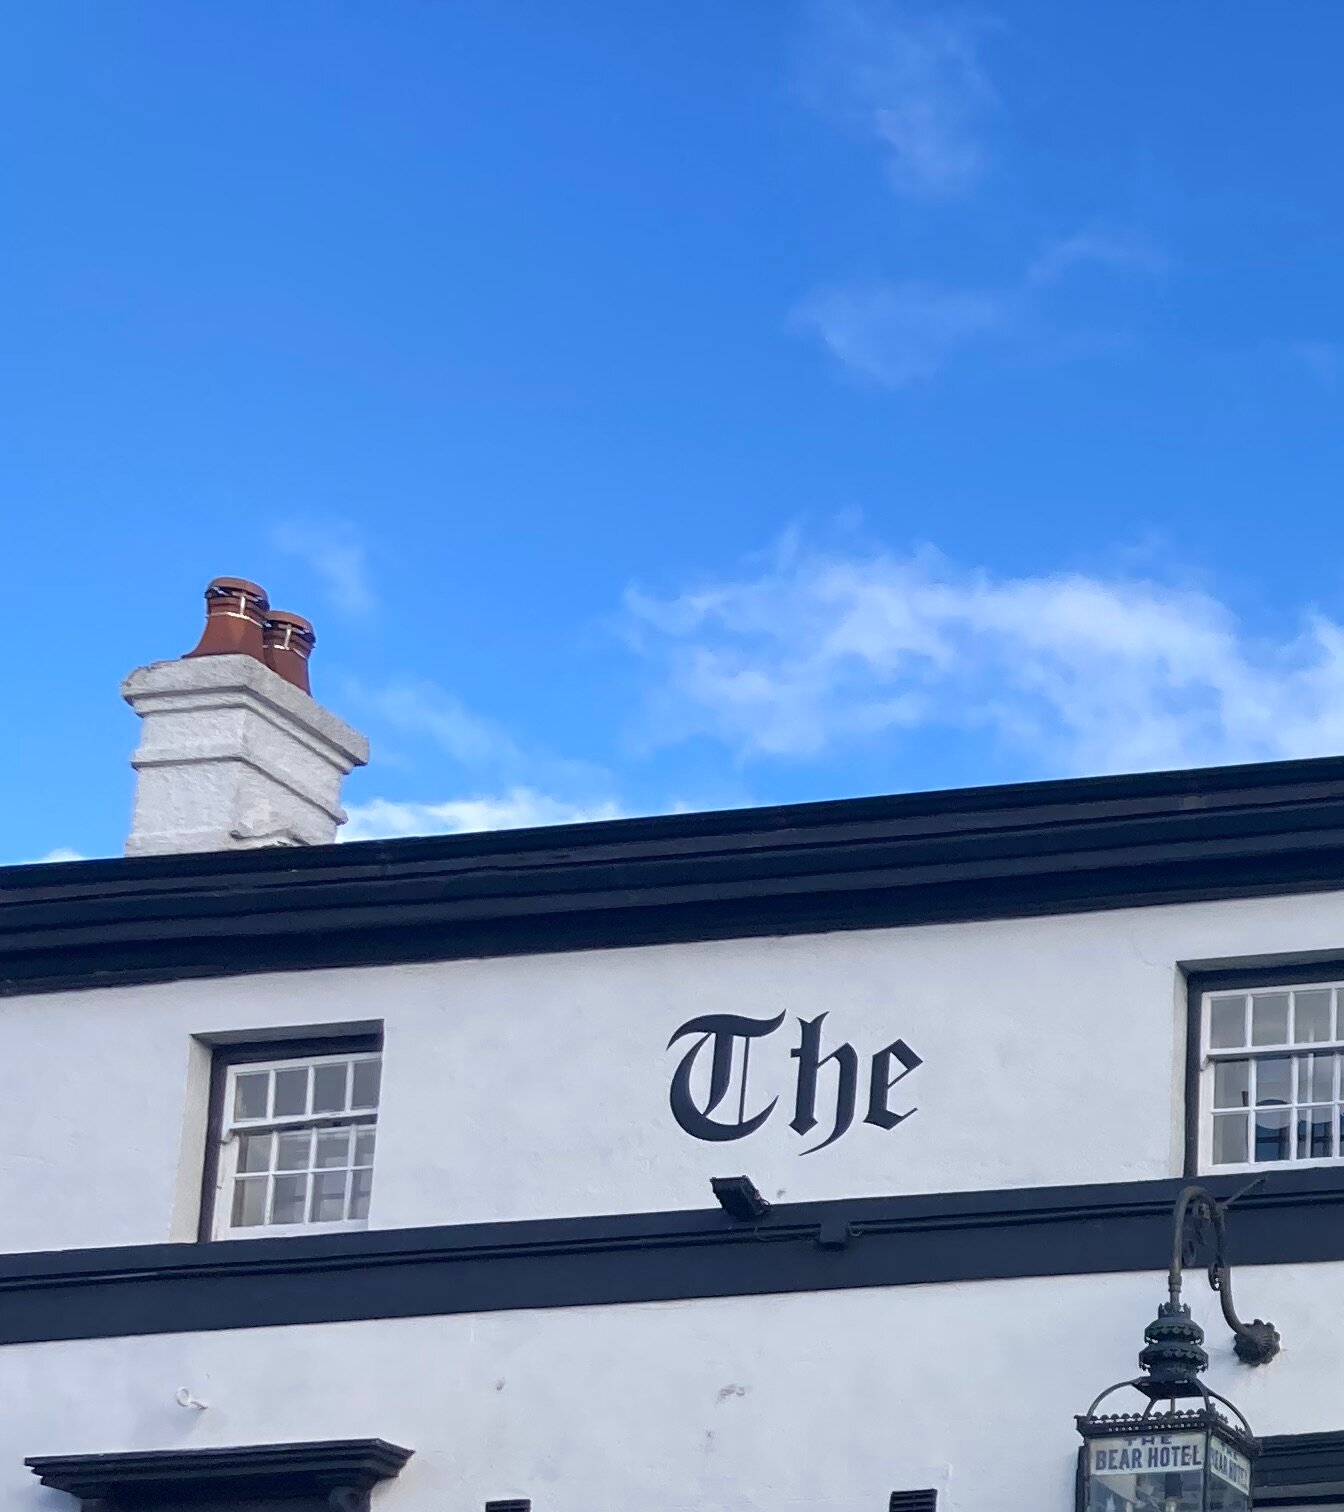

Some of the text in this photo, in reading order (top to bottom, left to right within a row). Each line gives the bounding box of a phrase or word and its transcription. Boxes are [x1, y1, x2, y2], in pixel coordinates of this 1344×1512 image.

[665, 1008, 924, 1157] The
[1095, 1448, 1143, 1471] BEAR
[1148, 1444, 1202, 1469] HOTEL
